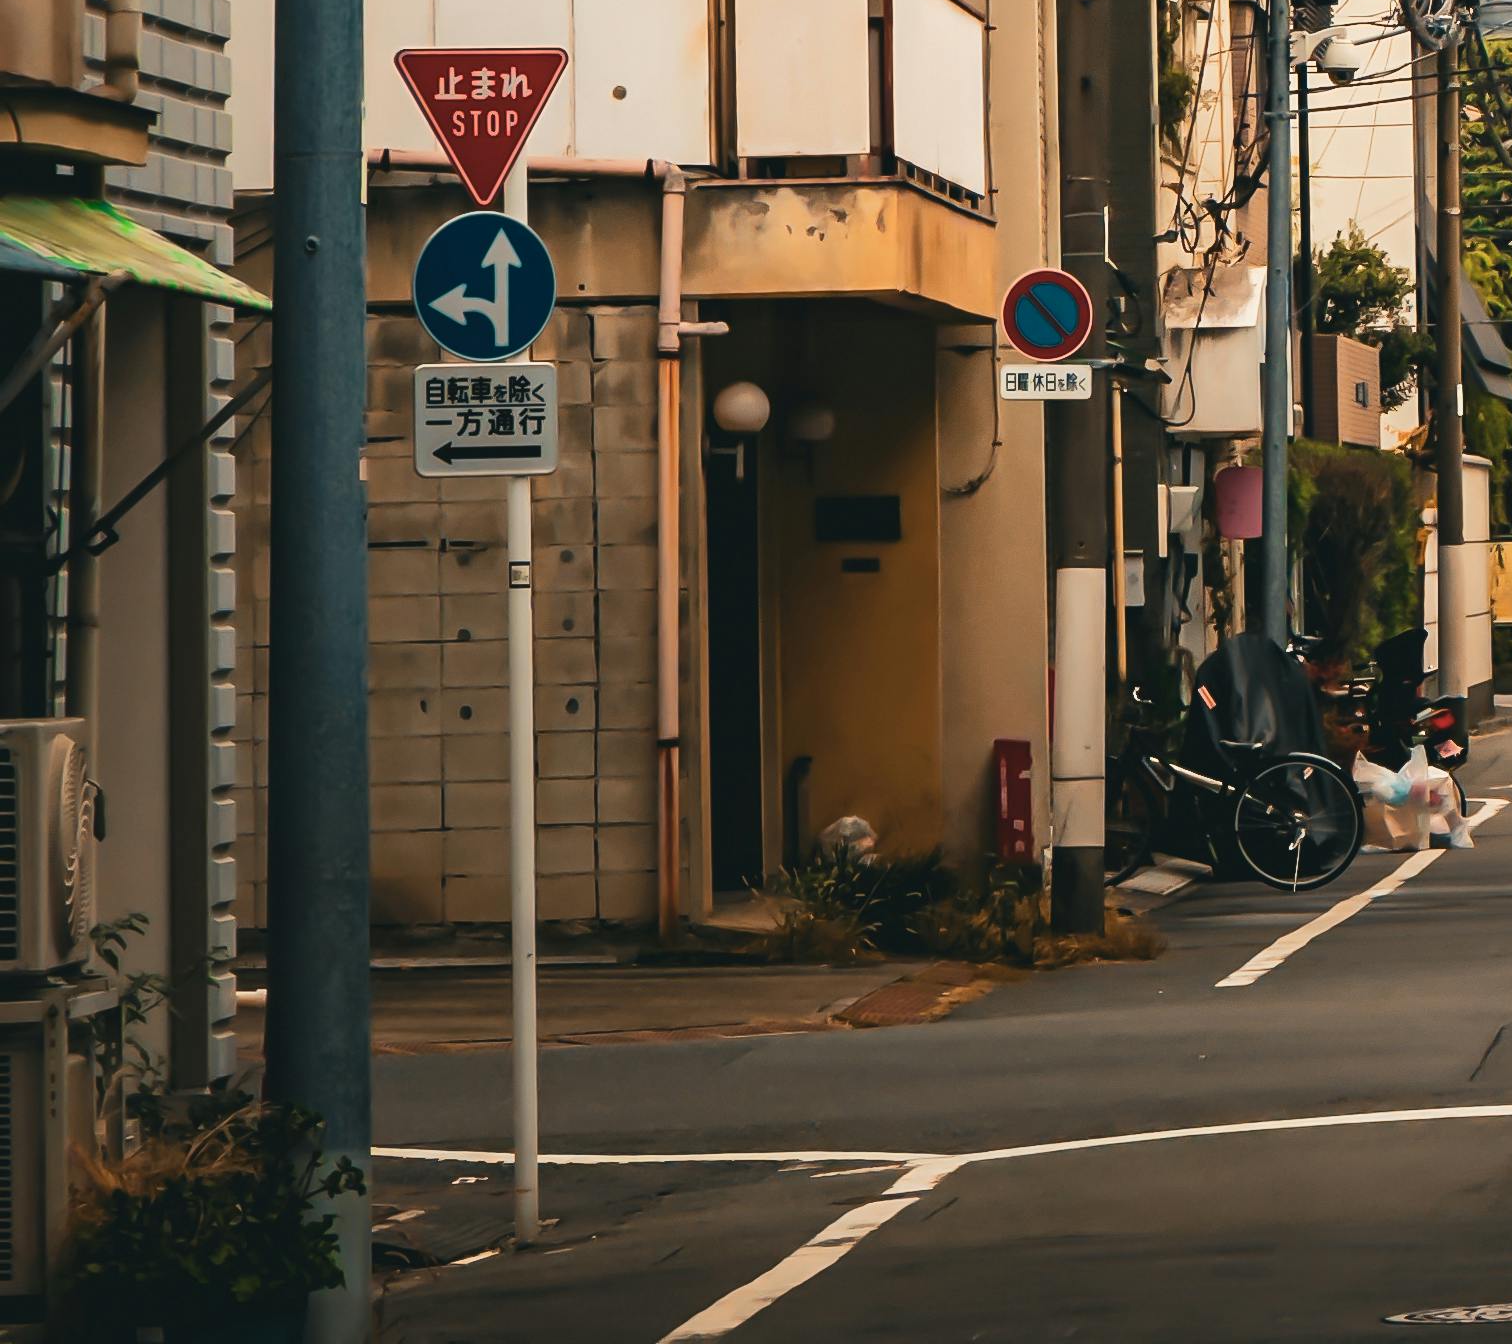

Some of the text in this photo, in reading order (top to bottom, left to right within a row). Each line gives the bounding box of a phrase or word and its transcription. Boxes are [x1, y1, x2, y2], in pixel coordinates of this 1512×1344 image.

[434, 67, 533, 100] 止まれ
[452, 110, 519, 137] STOP
[425, 376, 545, 405] 自転車を除く
[425, 409, 546, 437] 一方通行
